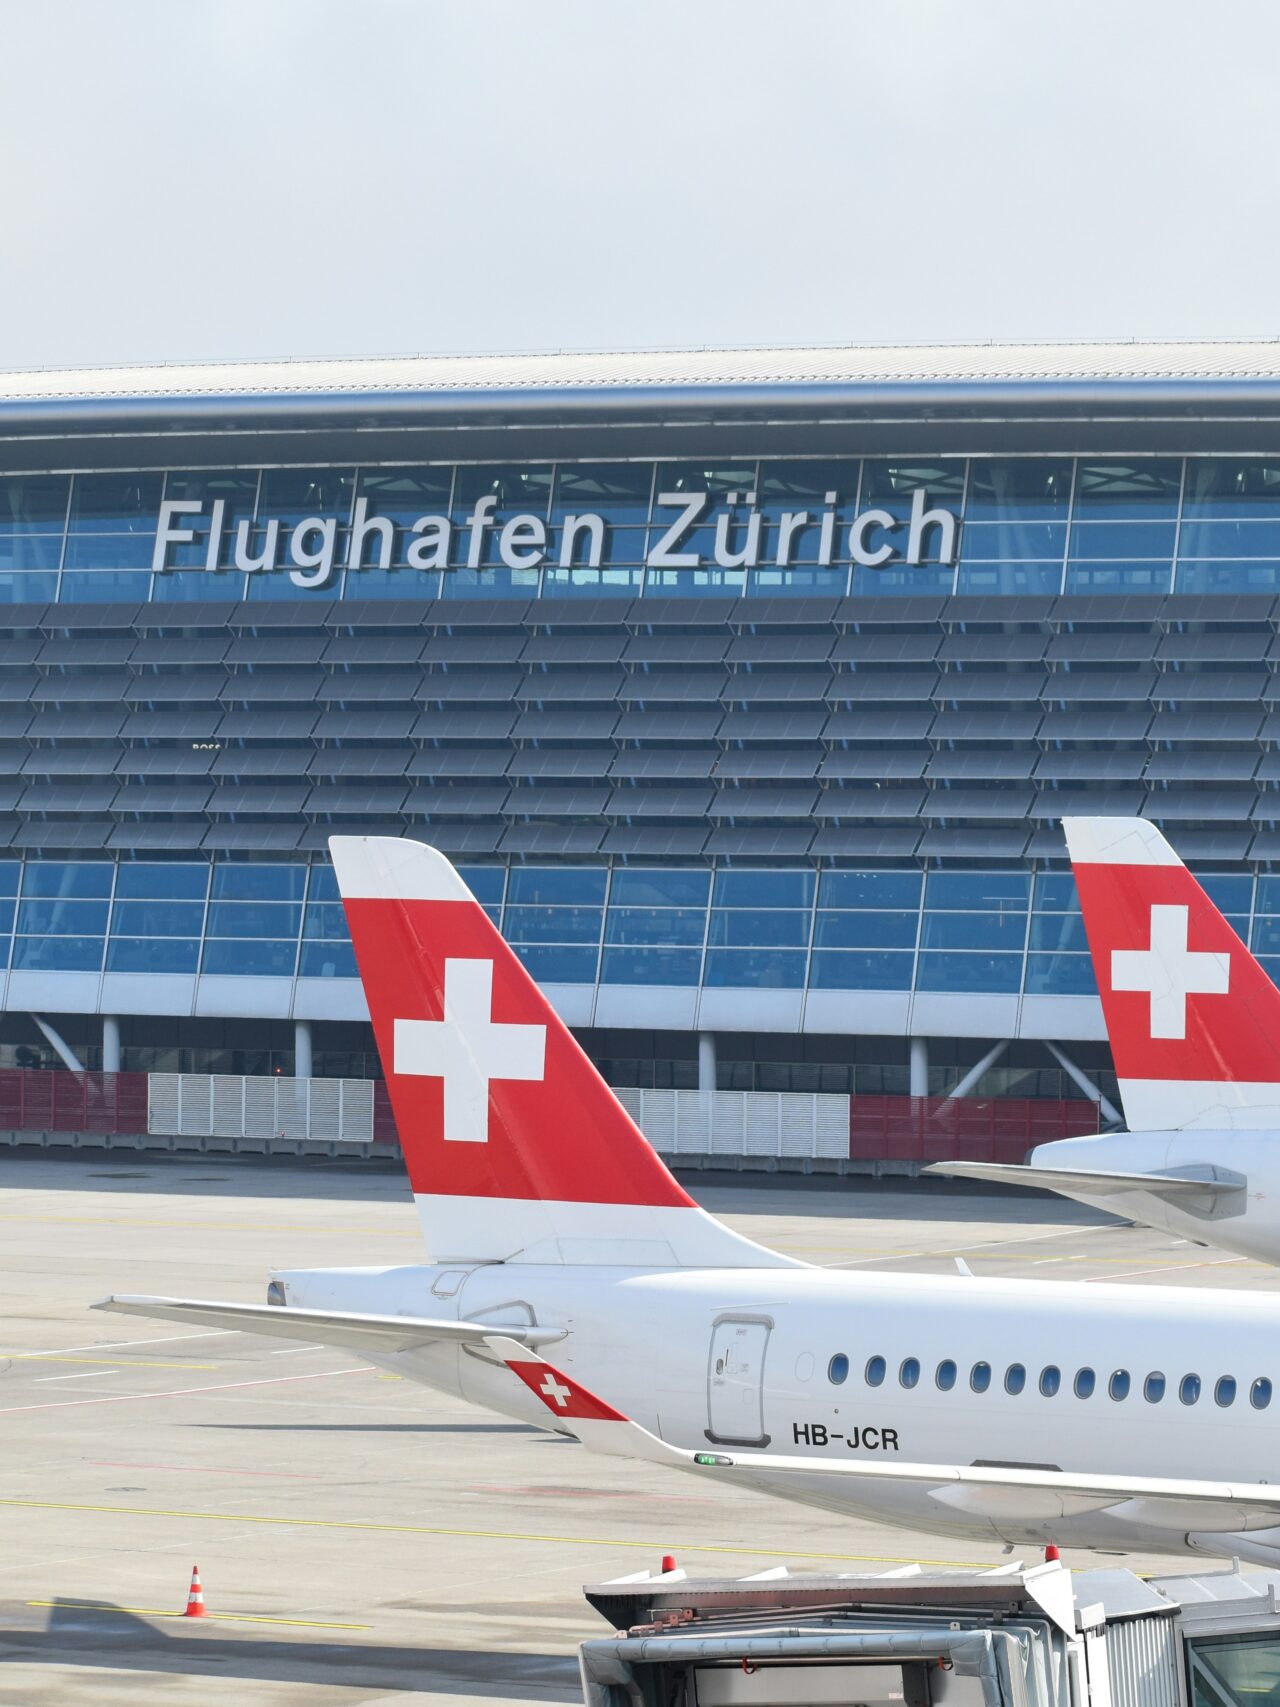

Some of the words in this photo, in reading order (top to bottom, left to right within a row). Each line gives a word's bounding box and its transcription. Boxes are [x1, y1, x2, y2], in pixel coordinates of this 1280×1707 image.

[153, 496, 605, 588] Flughafen
[647, 489, 956, 568] Zürich
[793, 1422, 899, 1450] HB-JCR
